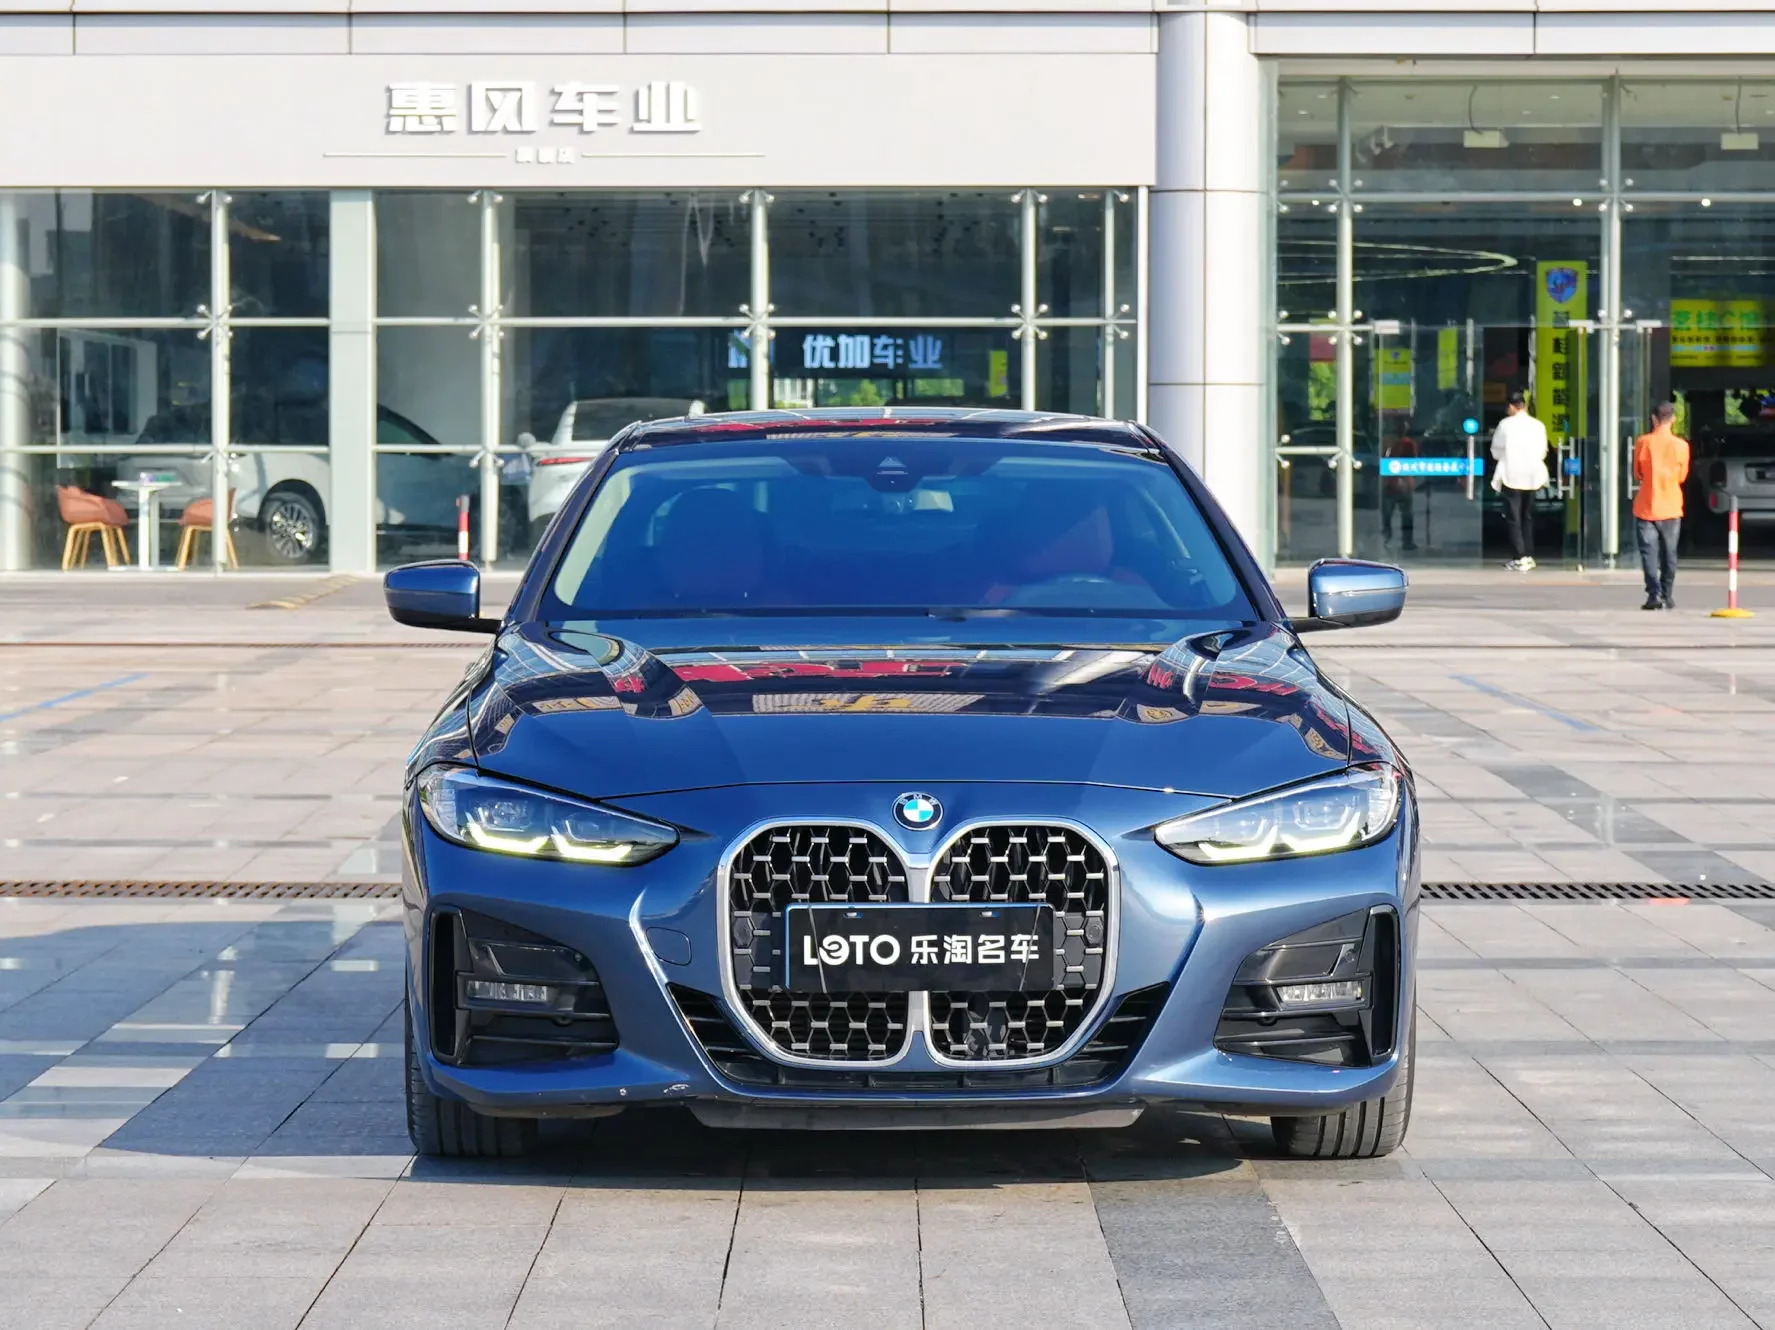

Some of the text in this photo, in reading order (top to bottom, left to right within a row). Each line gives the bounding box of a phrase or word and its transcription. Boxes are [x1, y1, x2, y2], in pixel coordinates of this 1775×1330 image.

[386, 80, 702, 134] 惠风车业
[802, 333, 943, 370] 优加车业
[898, 793, 939, 806] BMW
[803, 933, 1040, 966] LOTO 乐淘名车
